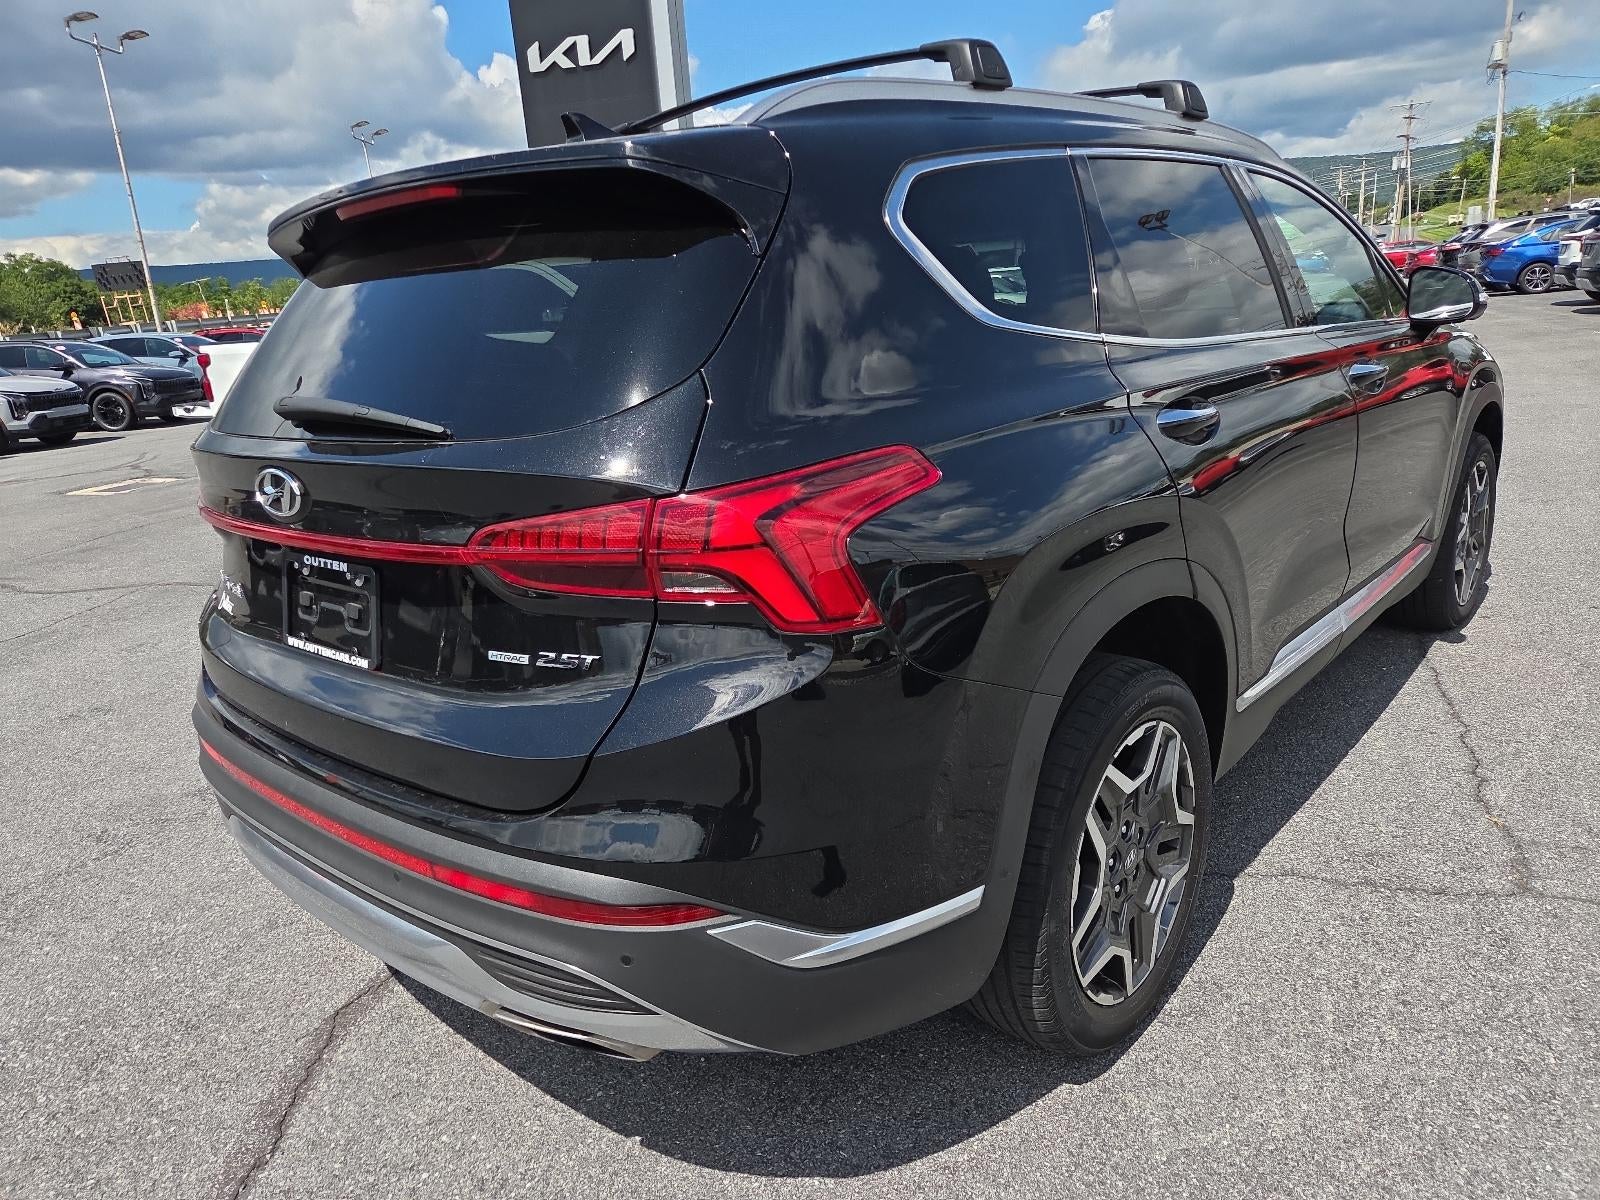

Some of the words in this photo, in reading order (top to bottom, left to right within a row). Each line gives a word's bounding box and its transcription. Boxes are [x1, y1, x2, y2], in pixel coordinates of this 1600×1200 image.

[303, 555, 348, 572] OUTTEN
[287, 636, 369, 669] WWW.OUTTENCARS.COM
[489, 651, 528, 664] HTRAC
